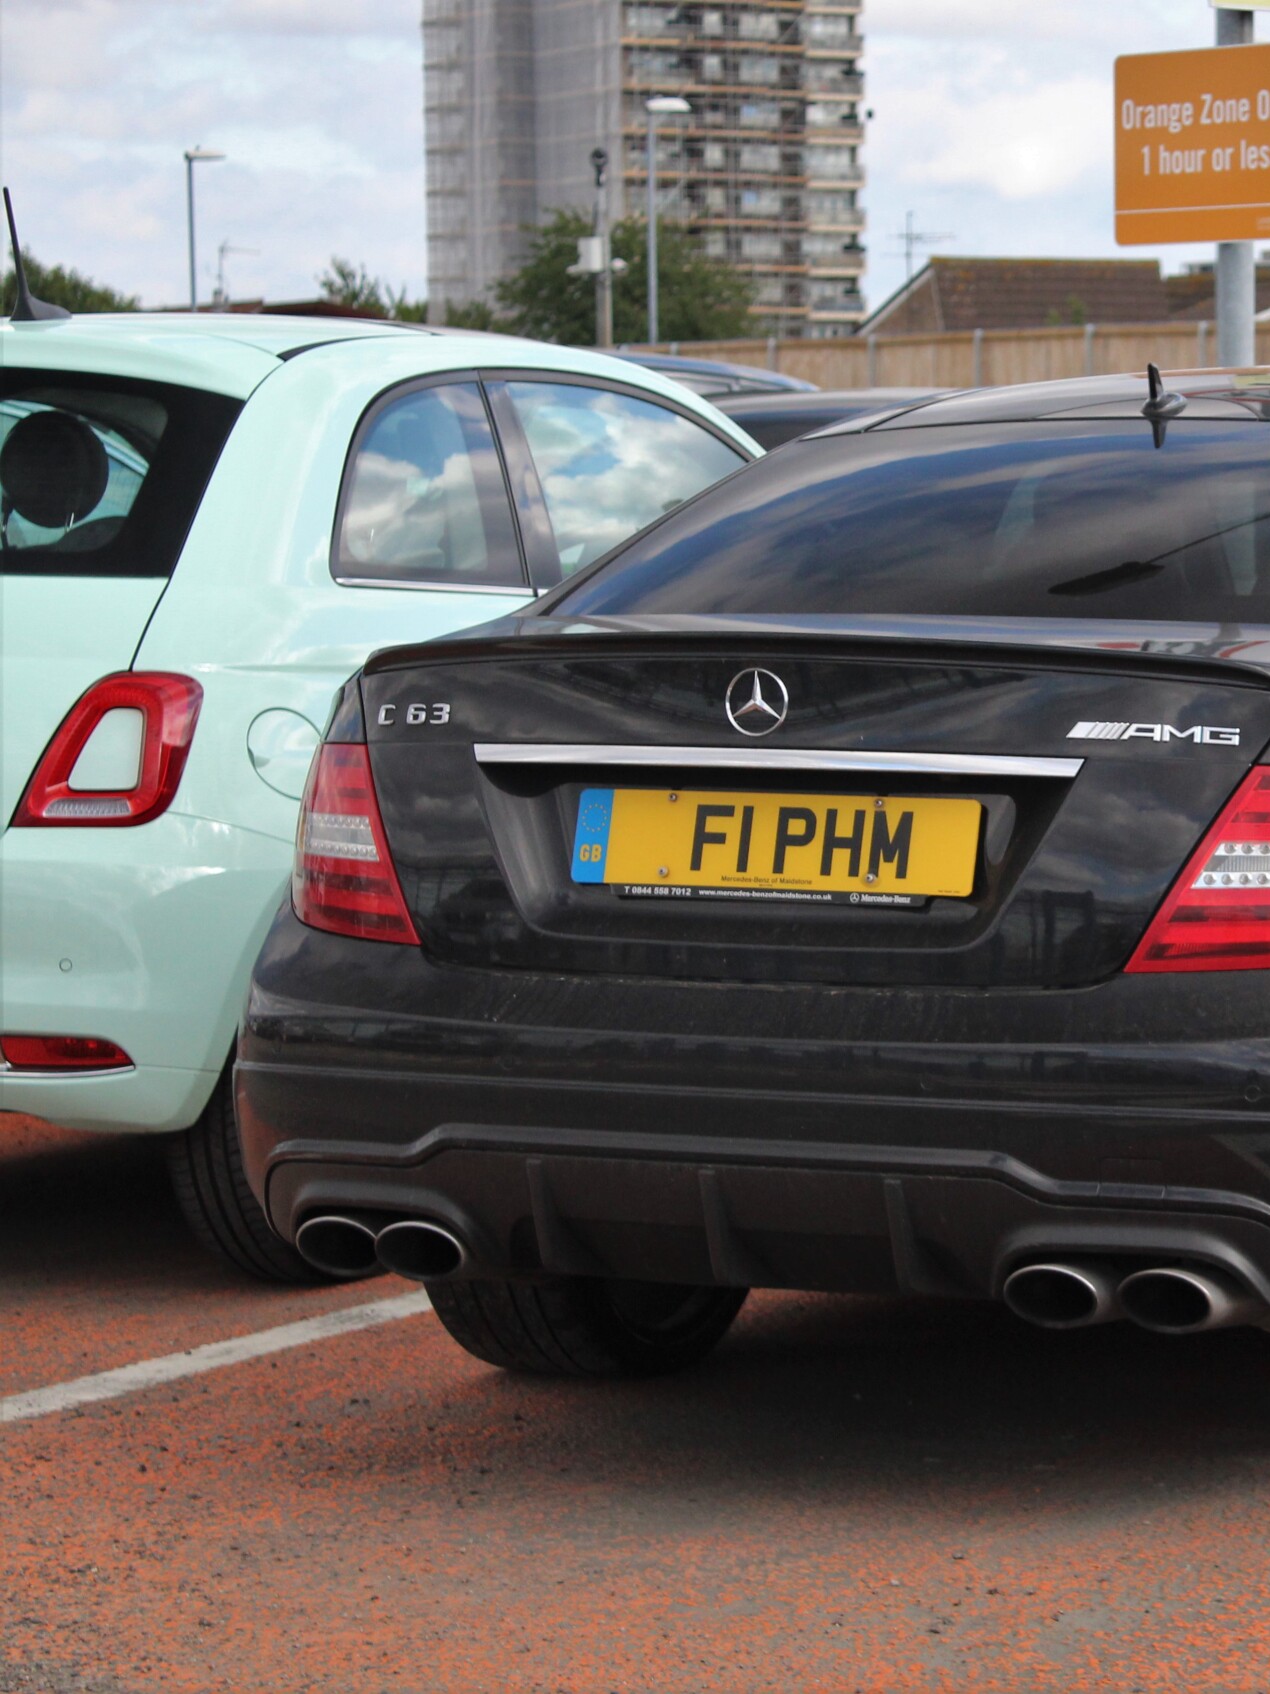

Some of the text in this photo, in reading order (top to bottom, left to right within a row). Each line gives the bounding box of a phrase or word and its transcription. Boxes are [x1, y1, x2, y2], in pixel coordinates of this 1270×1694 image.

[1121, 98, 1194, 134] Orange
[1199, 93, 1250, 125] Zone
[1141, 144, 1150, 176] 1
[1158, 144, 1206, 175] hour
[1211, 148, 1235, 172] or
[377, 702, 451, 726] C 63
[1120, 723, 1240, 746] AMG
[579, 843, 602, 862] GB
[772, 806, 914, 879] PHM
[721, 875, 770, 884] Mercedes-Benz
[624, 885, 692, 896] T 0844 558 7012
[699, 889, 832, 900] www.mercedes-benzofmaidstone.co.uk
[861, 893, 911, 904] Mercedes-Benz
